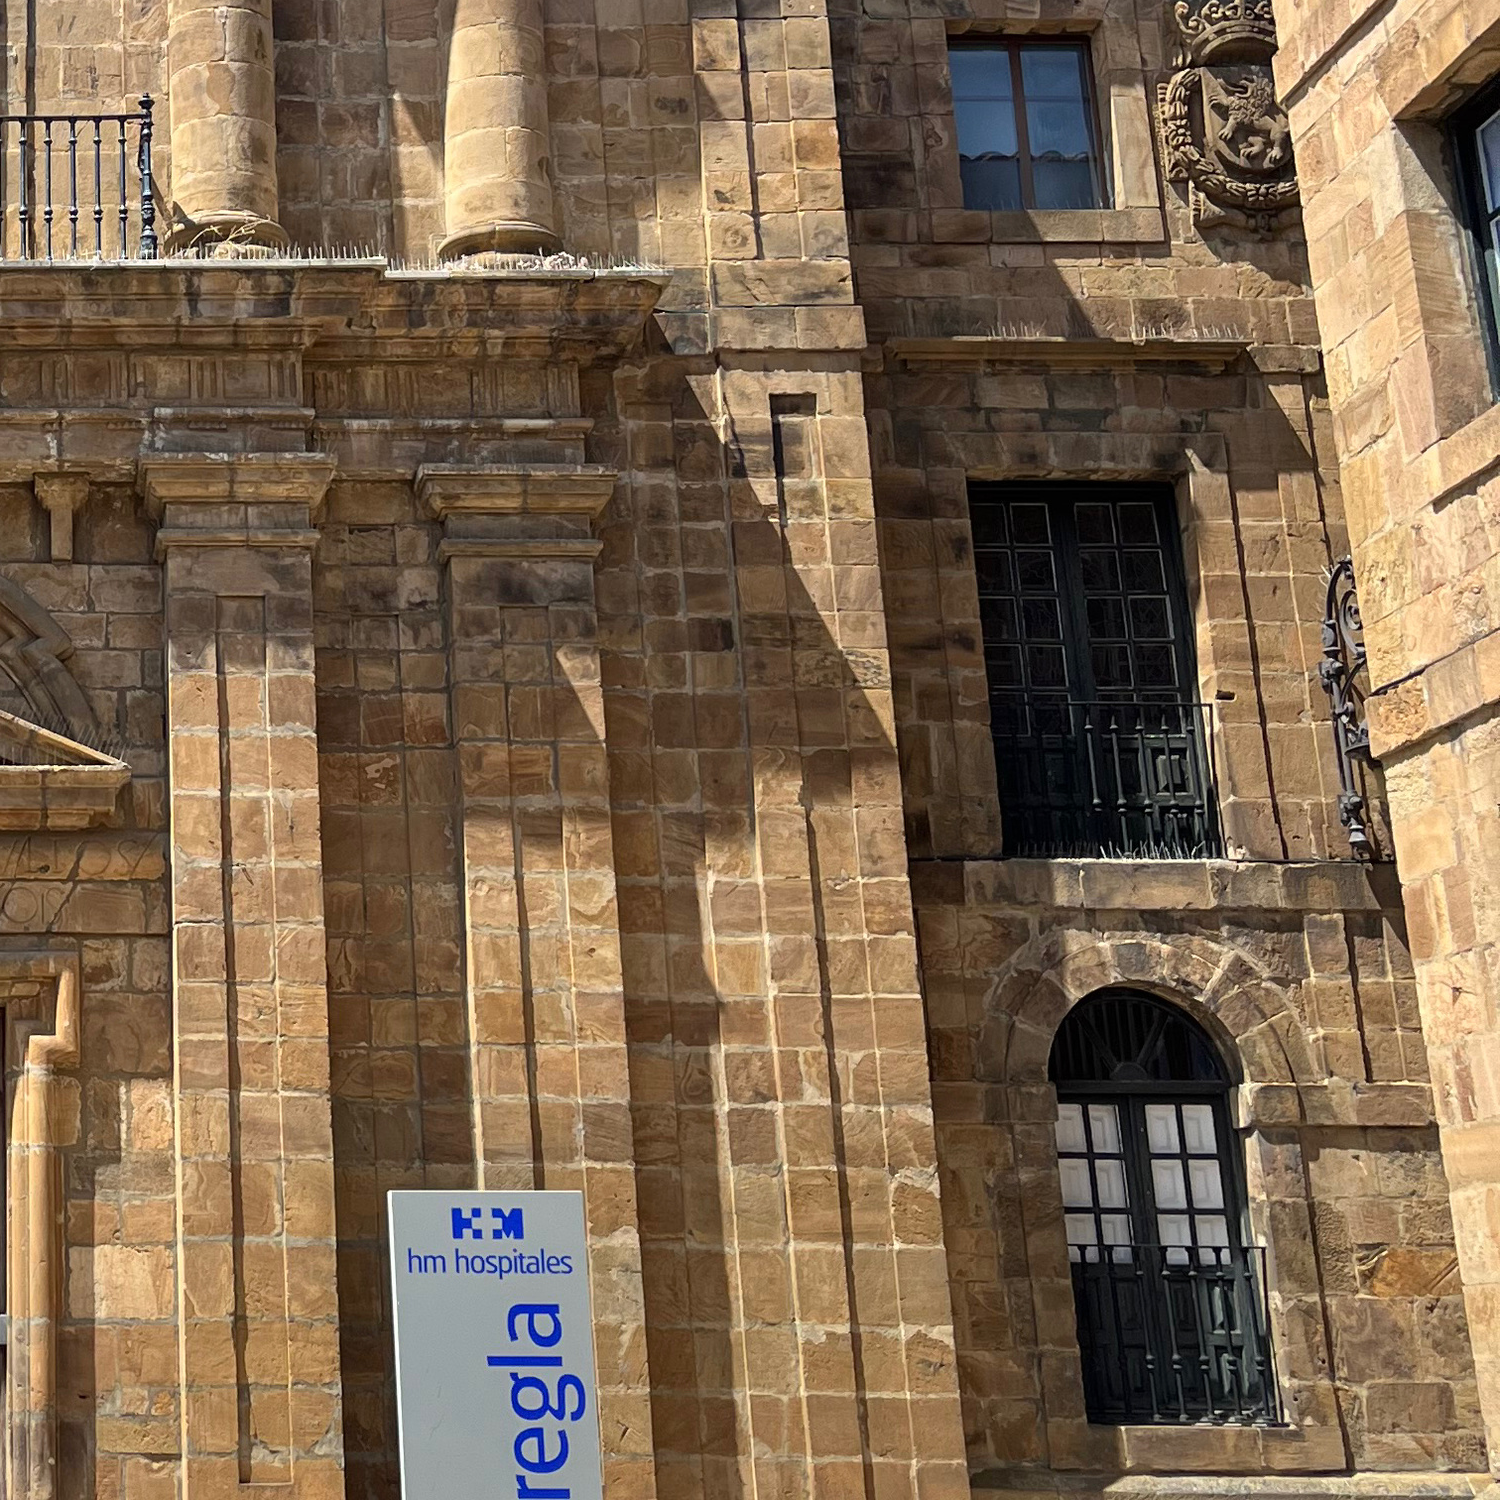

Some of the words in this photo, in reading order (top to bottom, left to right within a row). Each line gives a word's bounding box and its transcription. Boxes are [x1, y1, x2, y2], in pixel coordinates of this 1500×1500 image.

[407, 1247, 447, 1274] hm
[455, 1247, 573, 1280] hospitales
[486, 1303, 586, 1500] regla
